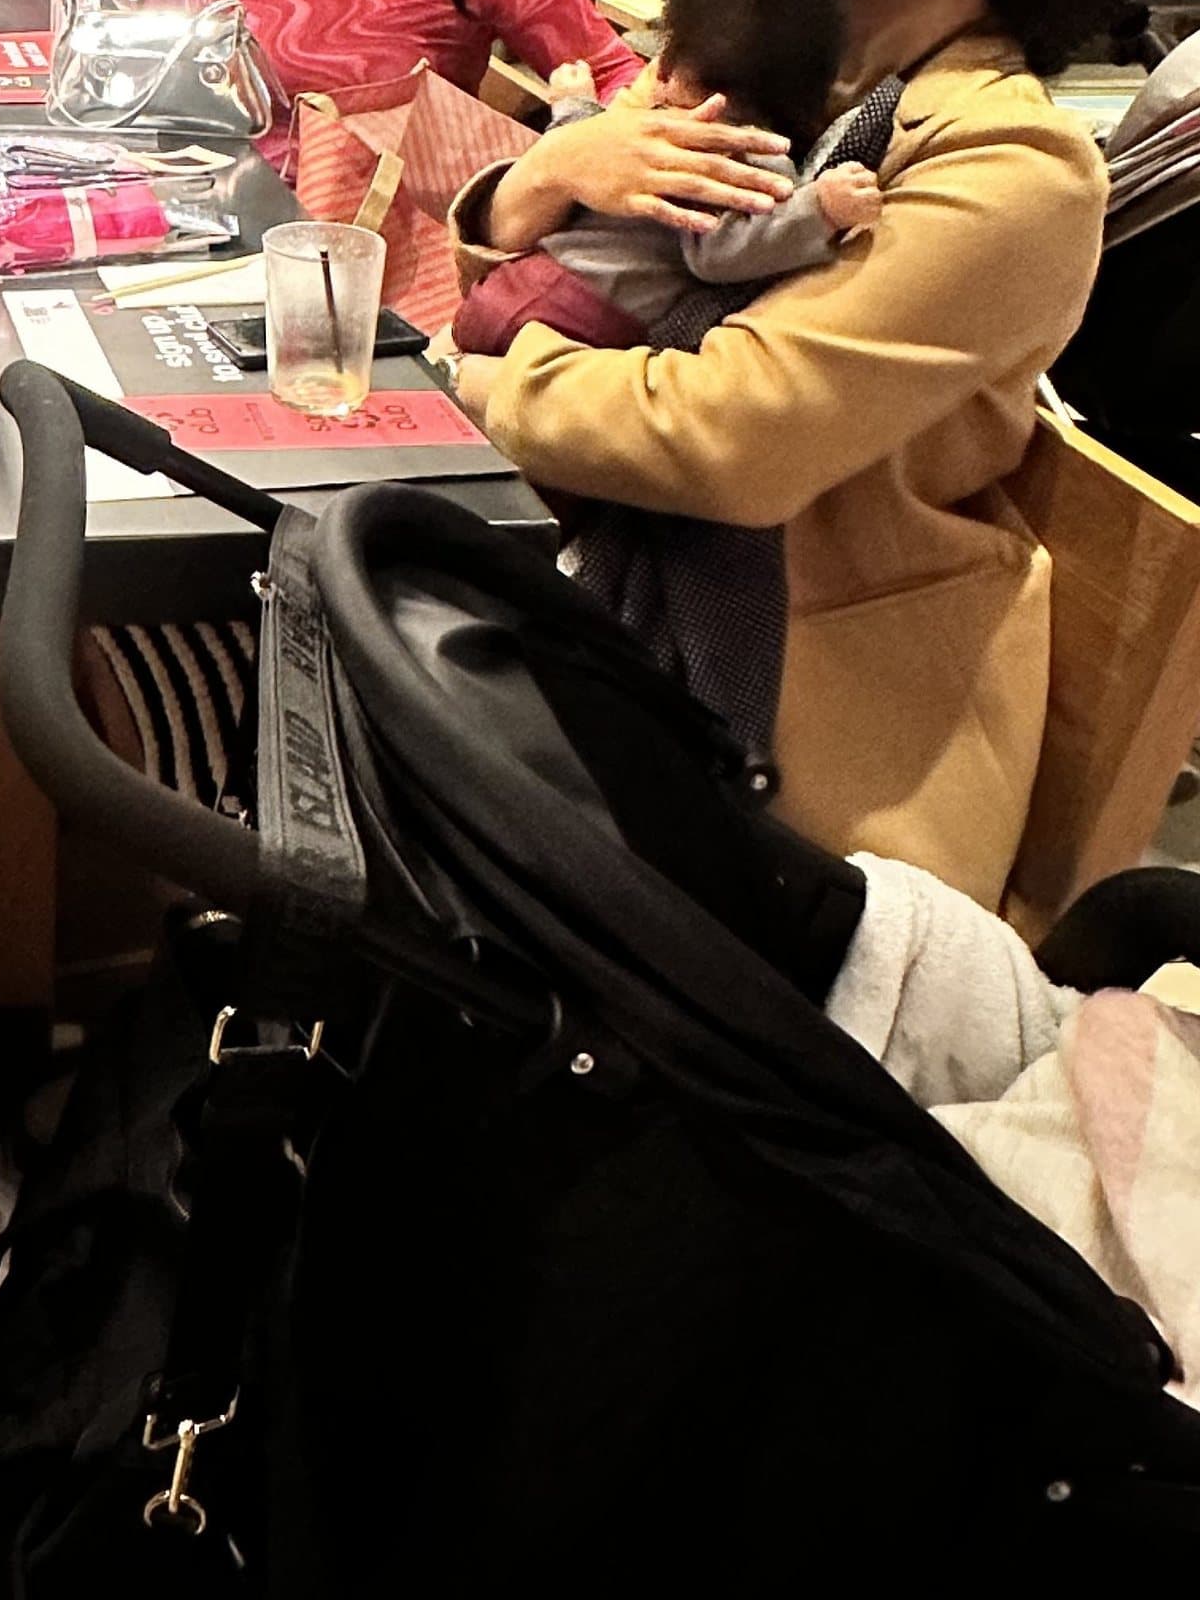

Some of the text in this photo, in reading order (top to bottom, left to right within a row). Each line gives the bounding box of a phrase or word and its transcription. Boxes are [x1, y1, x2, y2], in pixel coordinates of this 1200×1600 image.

[141, 315, 193, 368] sign up
[212, 364, 244, 382] to
[284, 709, 342, 837] ISLAND
